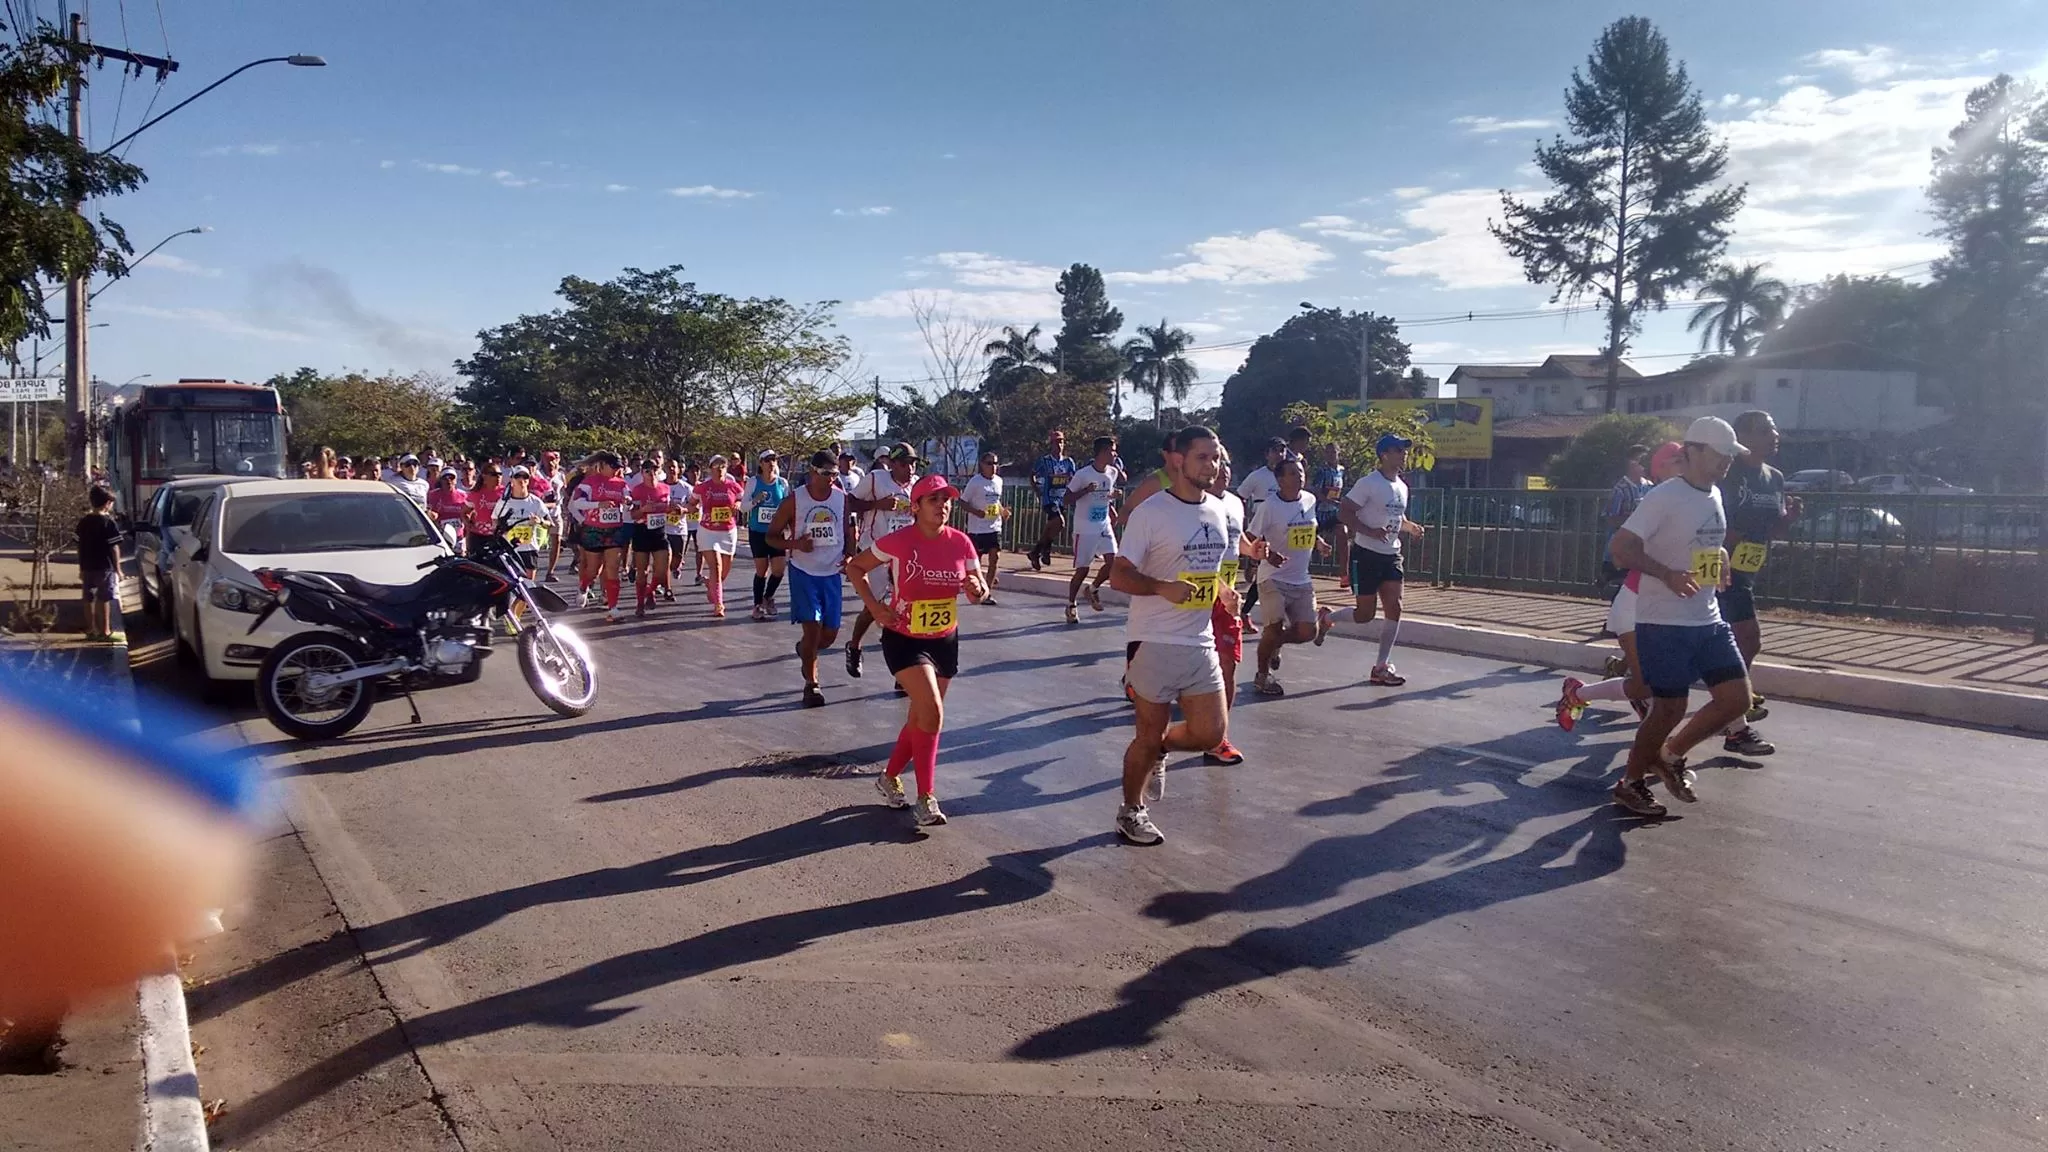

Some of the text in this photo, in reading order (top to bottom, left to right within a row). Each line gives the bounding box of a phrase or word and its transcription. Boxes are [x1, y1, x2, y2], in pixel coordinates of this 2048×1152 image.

[602, 512, 618, 521] 005
[714, 512, 729, 522] 125
[650, 518, 665, 527] 080
[811, 526, 834, 539] 1530
[1293, 534, 1313, 546] 117
[918, 610, 951, 627] 123
